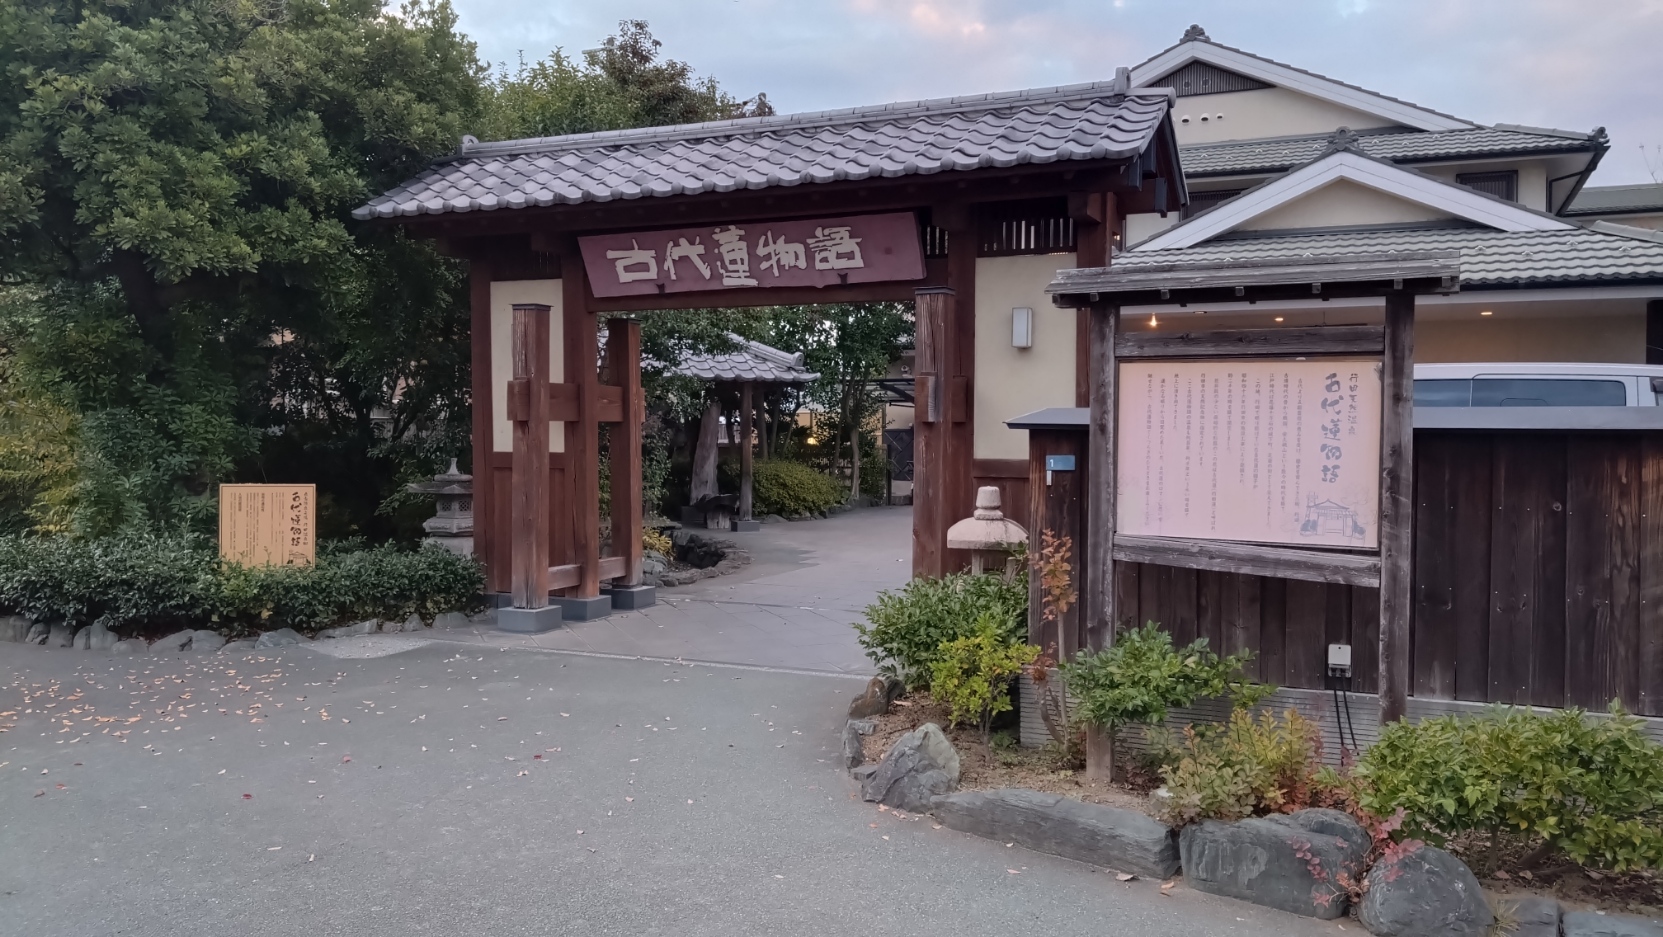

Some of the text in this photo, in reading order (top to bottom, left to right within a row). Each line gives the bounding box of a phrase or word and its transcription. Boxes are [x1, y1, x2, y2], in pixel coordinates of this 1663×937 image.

[606, 225, 865, 287] 古代蓮物語
[1320, 372, 1344, 484] 古代蓮物語
[1050, 459, 1054, 468] 1
[290, 491, 302, 546] 古代蓮物語
